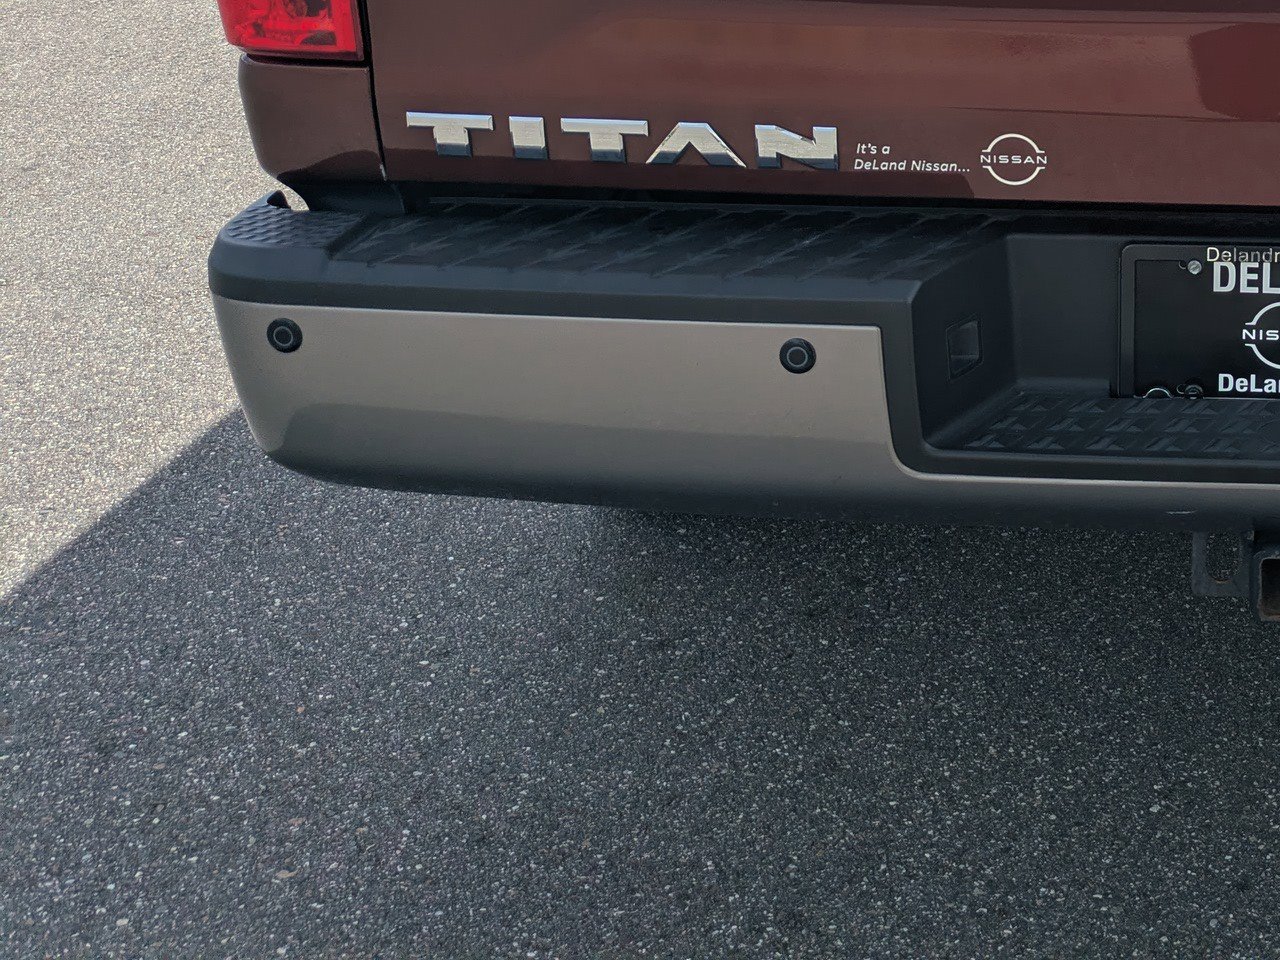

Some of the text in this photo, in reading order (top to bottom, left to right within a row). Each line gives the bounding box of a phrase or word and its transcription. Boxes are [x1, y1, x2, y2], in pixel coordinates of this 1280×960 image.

[405, 111, 840, 171] TITAN
[856, 142, 891, 155] It's a
[853, 158, 971, 173] DeLand Nissan...
[980, 154, 1048, 165] NISSAN
